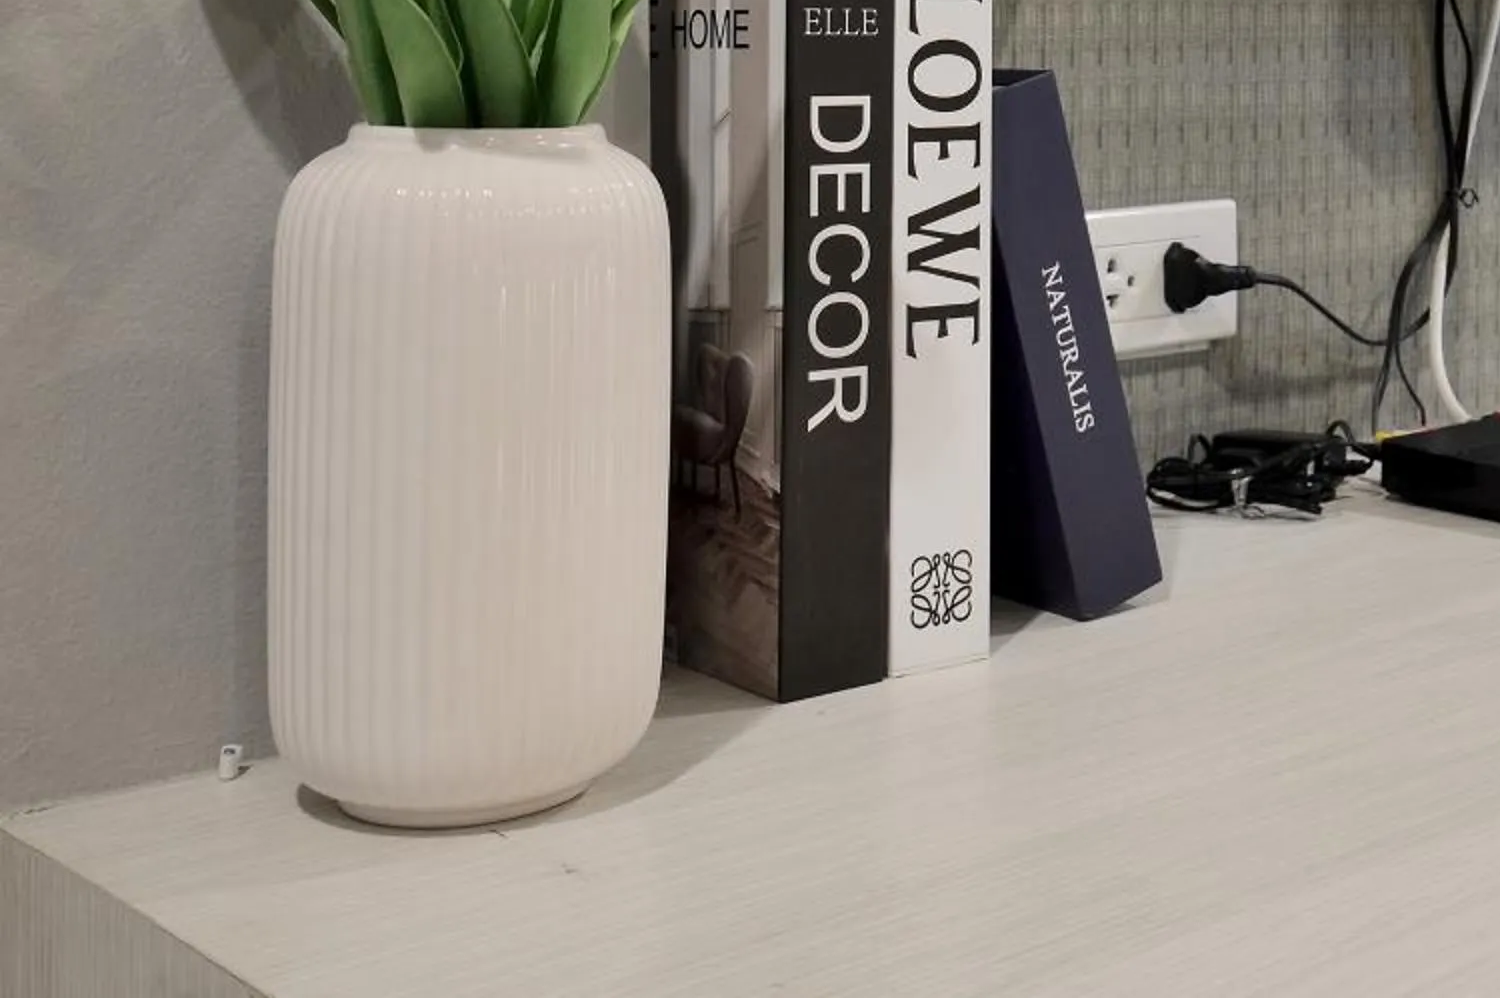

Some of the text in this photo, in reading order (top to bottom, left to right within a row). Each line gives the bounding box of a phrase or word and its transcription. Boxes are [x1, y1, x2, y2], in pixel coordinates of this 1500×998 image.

[671, 9, 750, 49] HOME
[803, 7, 879, 36] ELLE
[807, 94, 872, 433] DECOR
[1041, 261, 1096, 434] NATURALIS
